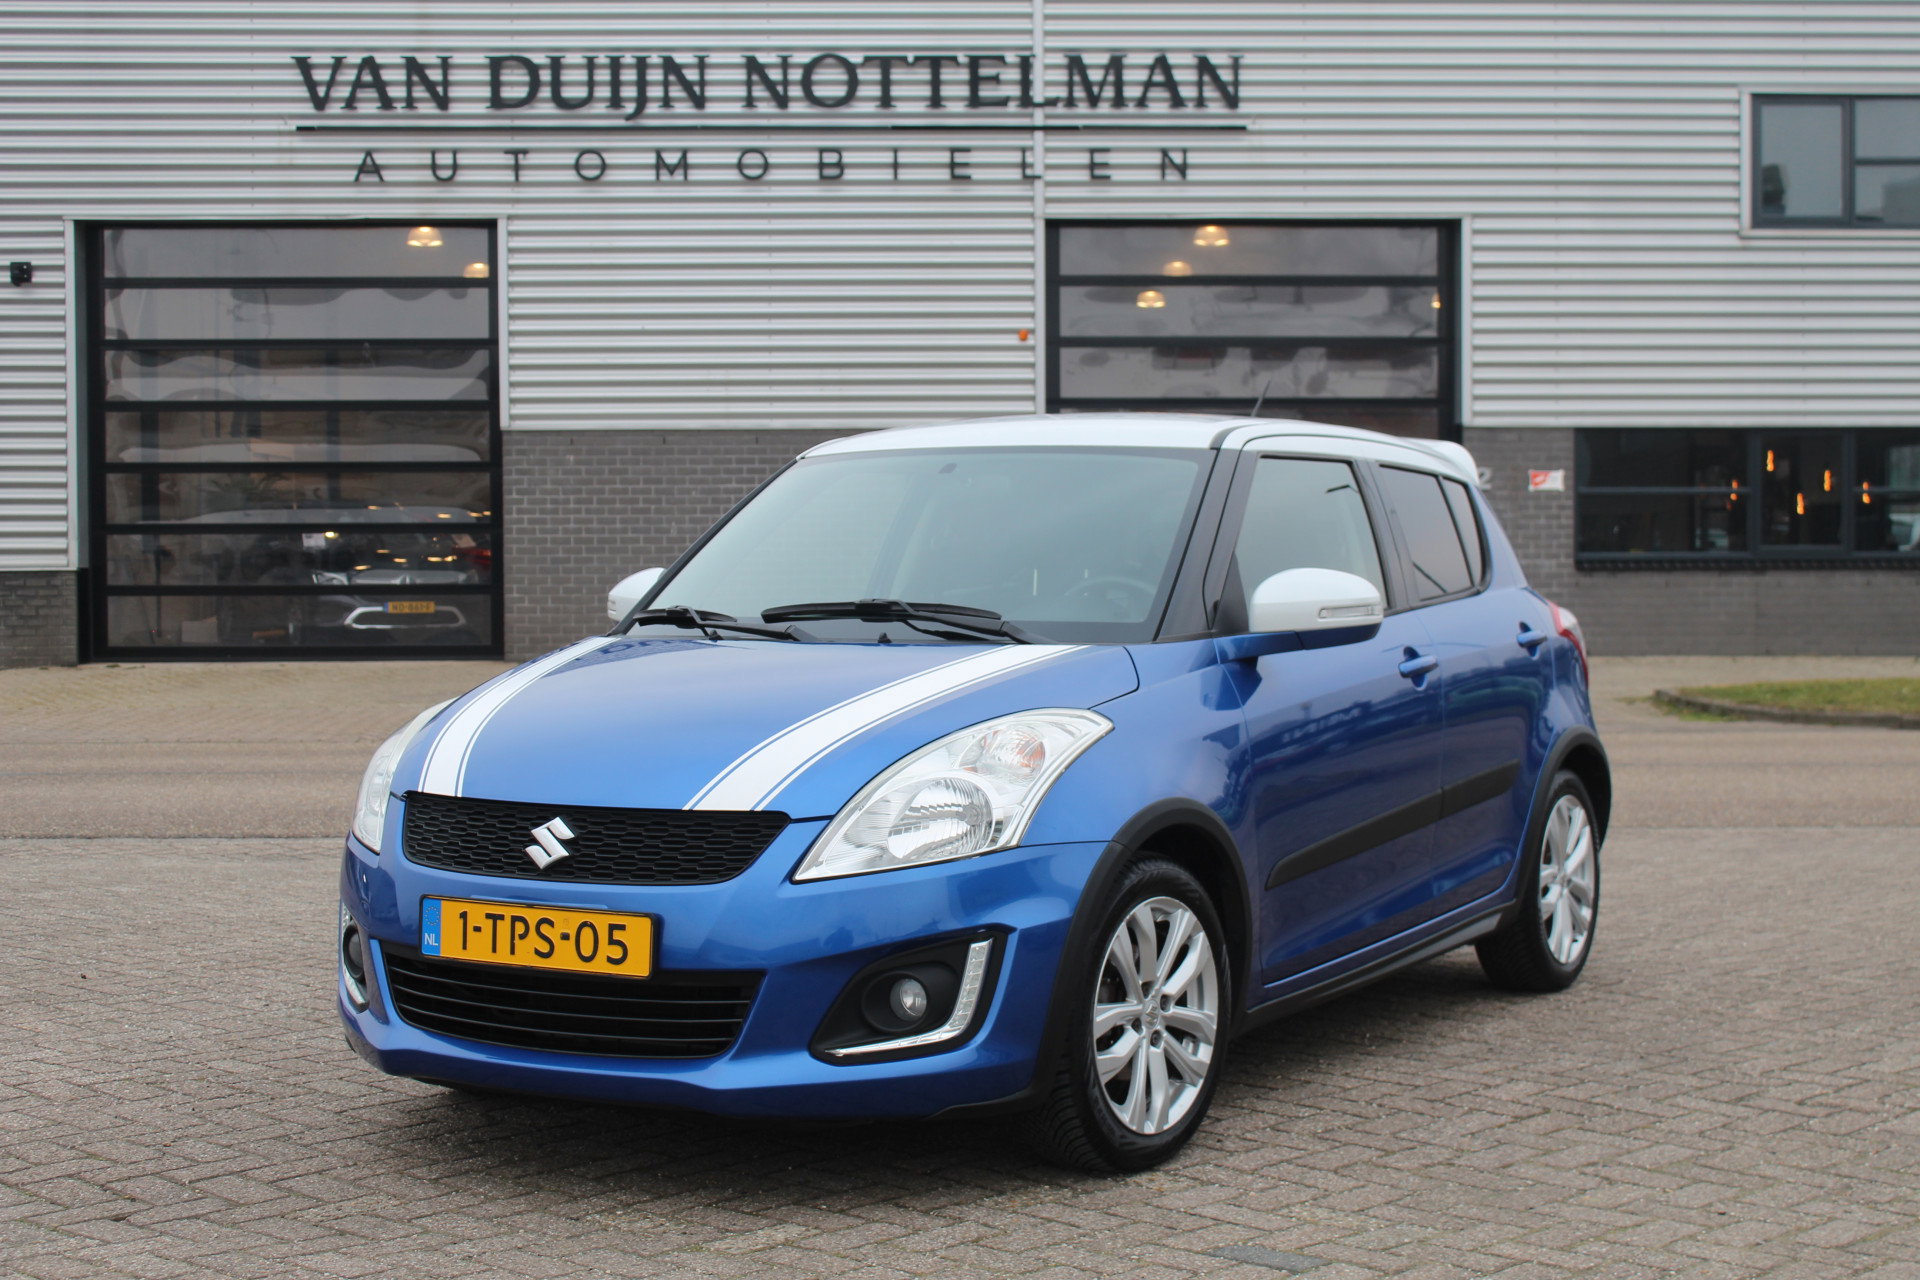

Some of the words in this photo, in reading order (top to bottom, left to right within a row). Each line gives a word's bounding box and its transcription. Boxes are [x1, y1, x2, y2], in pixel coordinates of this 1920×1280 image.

[291, 55, 452, 111] VAN
[484, 55, 709, 121] DUIJN
[741, 53, 1244, 110] NOTTELMAN
[354, 148, 1187, 182] AUTOMOBIELEN
[424, 932, 439, 947] NL
[458, 910, 629, 966] 1-TPS-05
